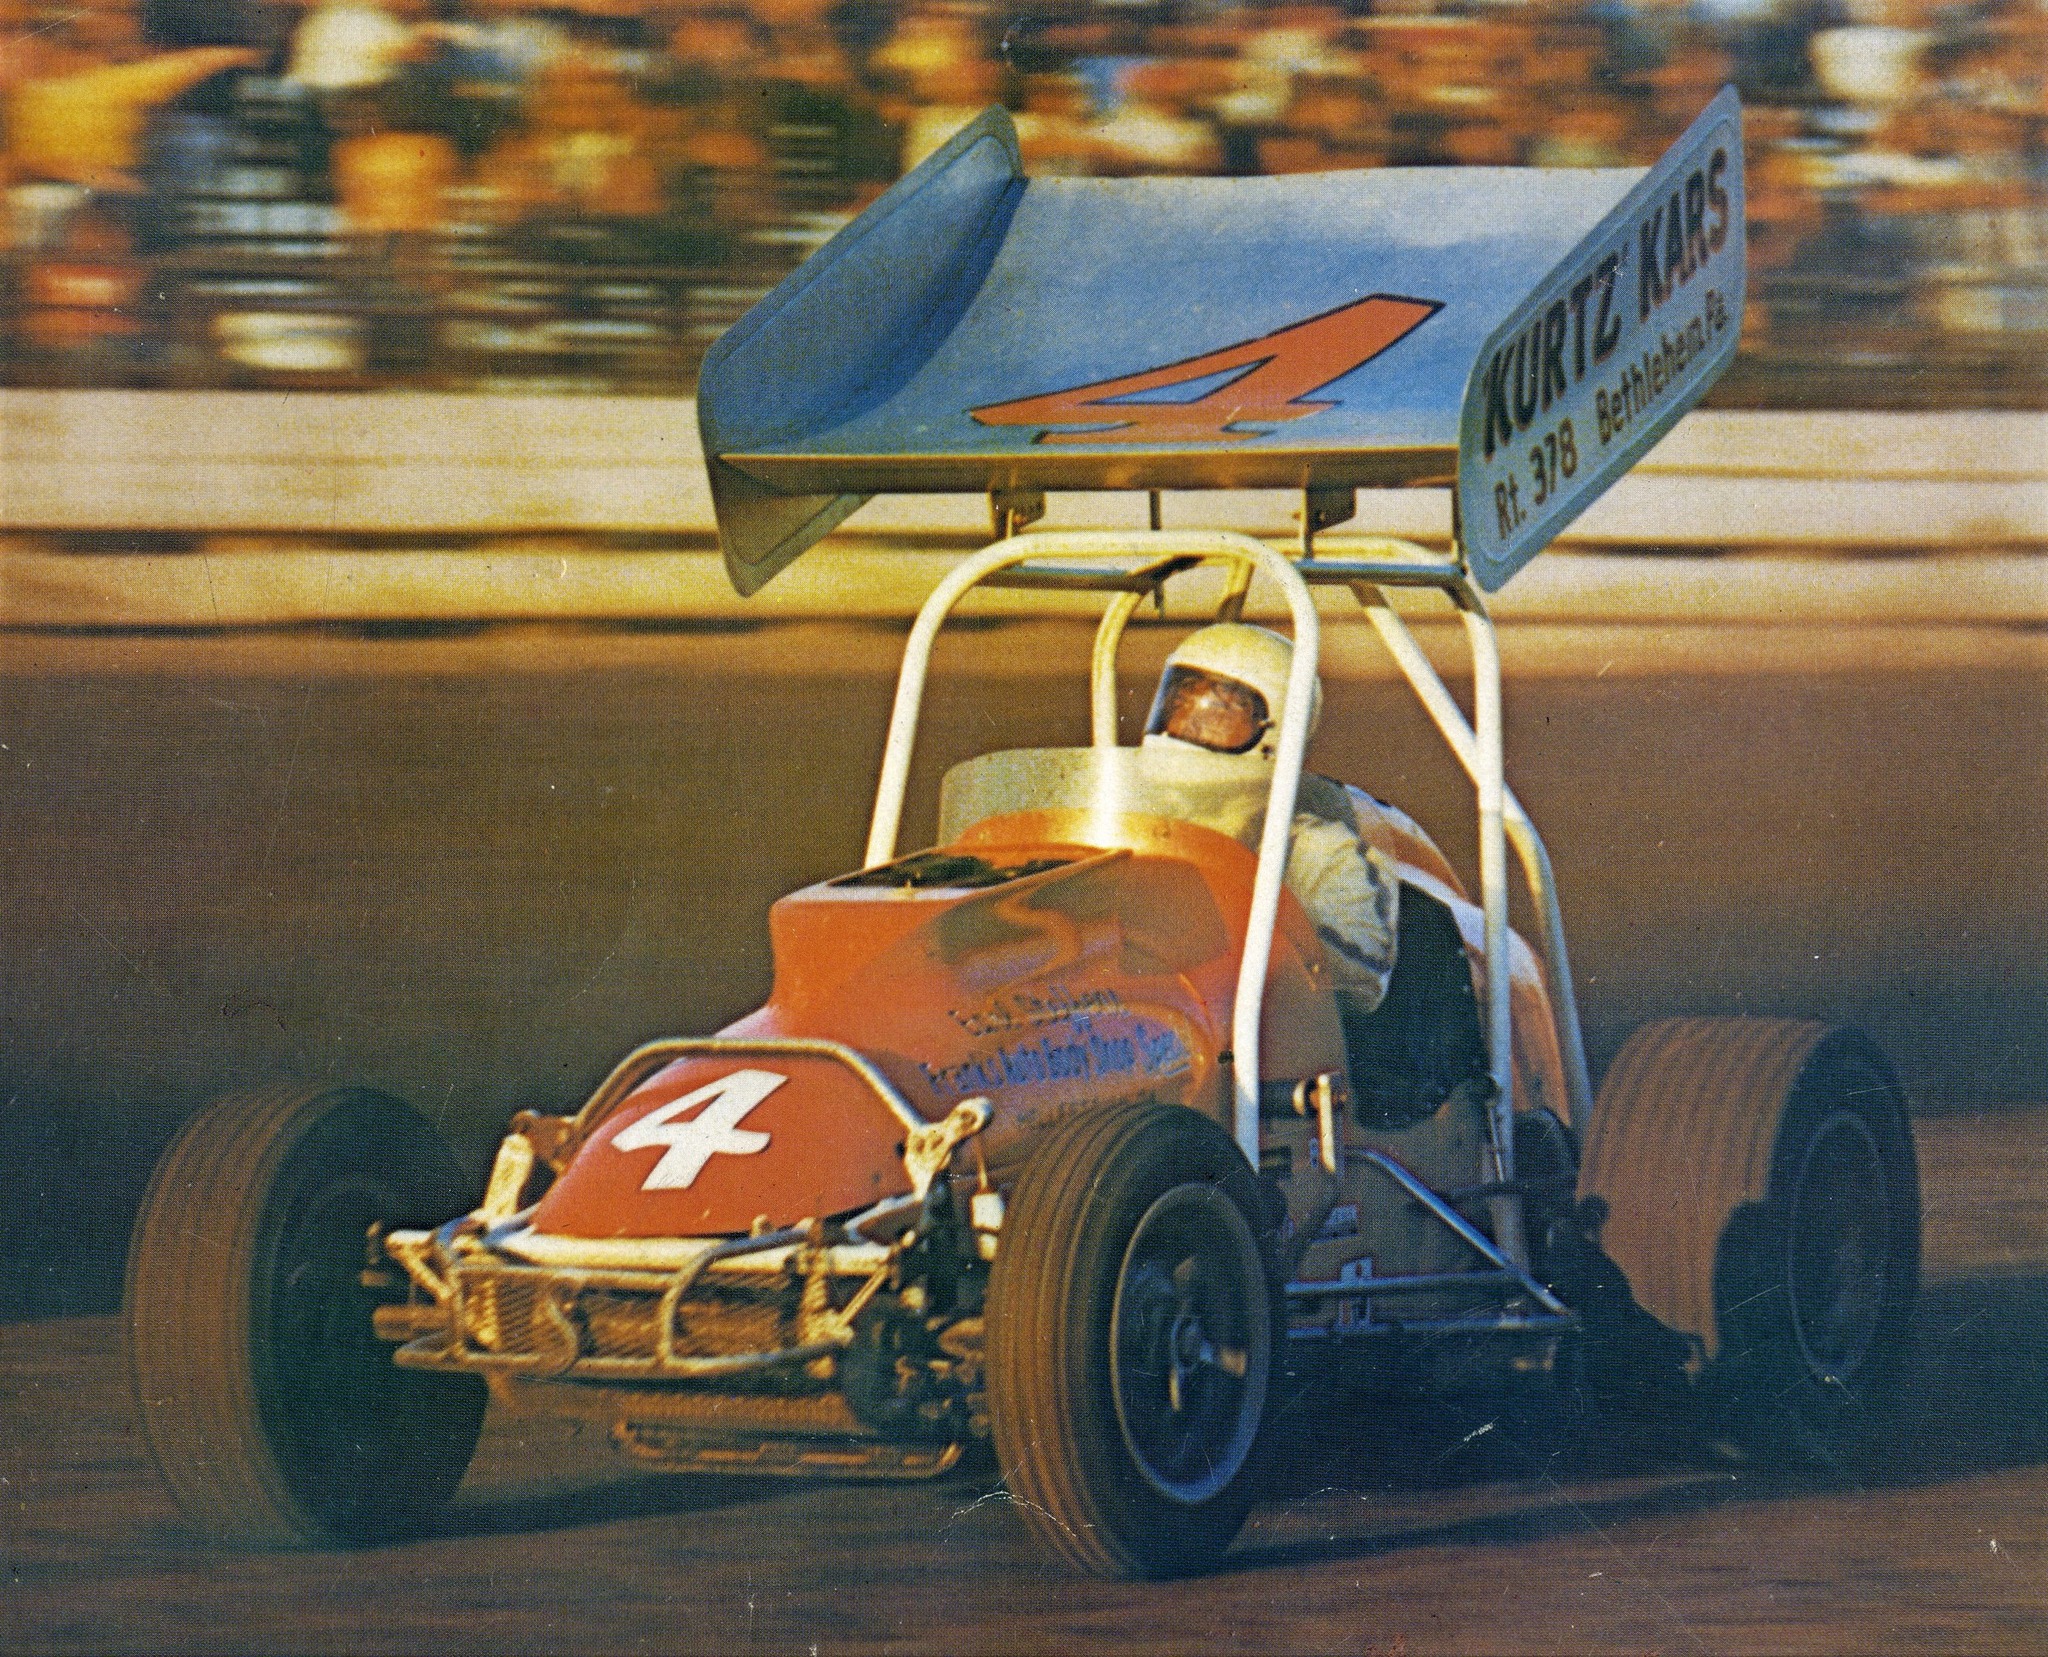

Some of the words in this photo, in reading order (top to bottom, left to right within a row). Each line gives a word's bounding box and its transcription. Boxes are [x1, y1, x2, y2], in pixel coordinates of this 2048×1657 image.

[1639, 146, 1729, 323] KARS
[966, 292, 1447, 444] 4
[1493, 471, 1528, 540] Rt.
[1528, 416, 1580, 506] 378
[609, 1067, 789, 1192] 4
